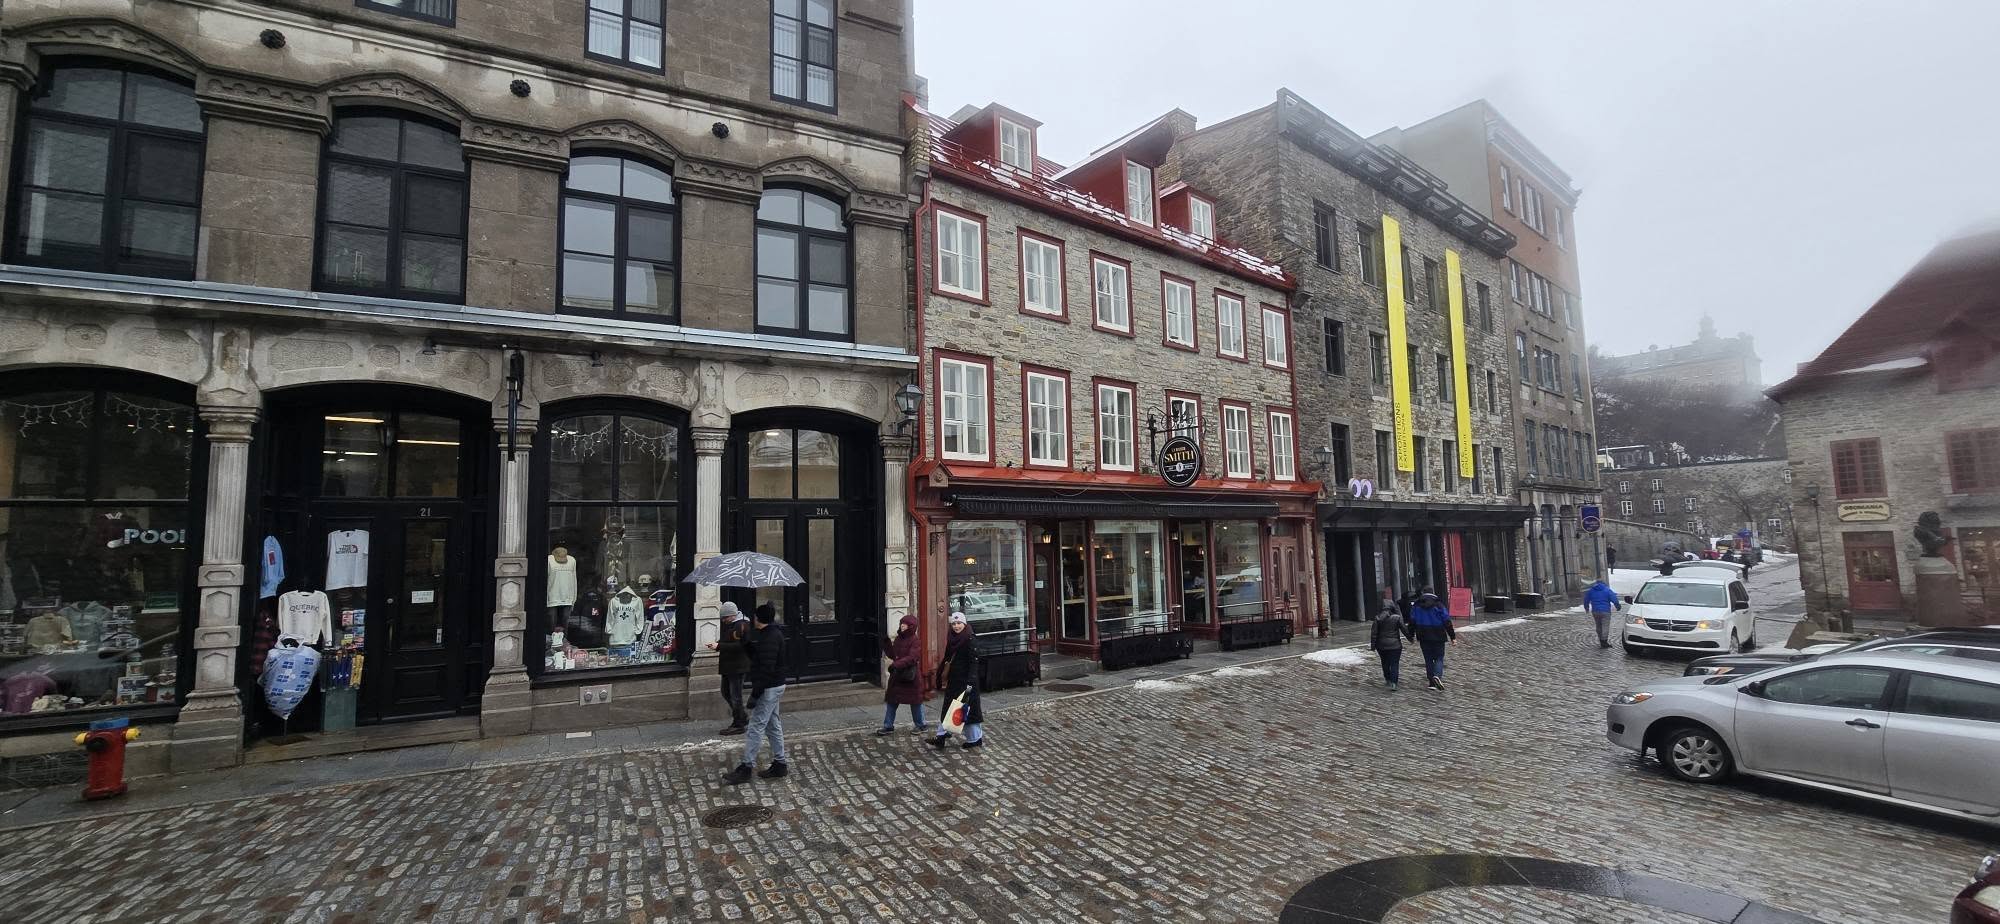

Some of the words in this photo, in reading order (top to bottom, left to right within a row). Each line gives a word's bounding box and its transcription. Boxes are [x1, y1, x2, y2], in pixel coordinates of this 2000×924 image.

[1395, 402, 1404, 468] EXPOSITIONS
[1164, 450, 1194, 462] SMITH
[420, 507, 431, 517] 21
[816, 507, 829, 516] 21A
